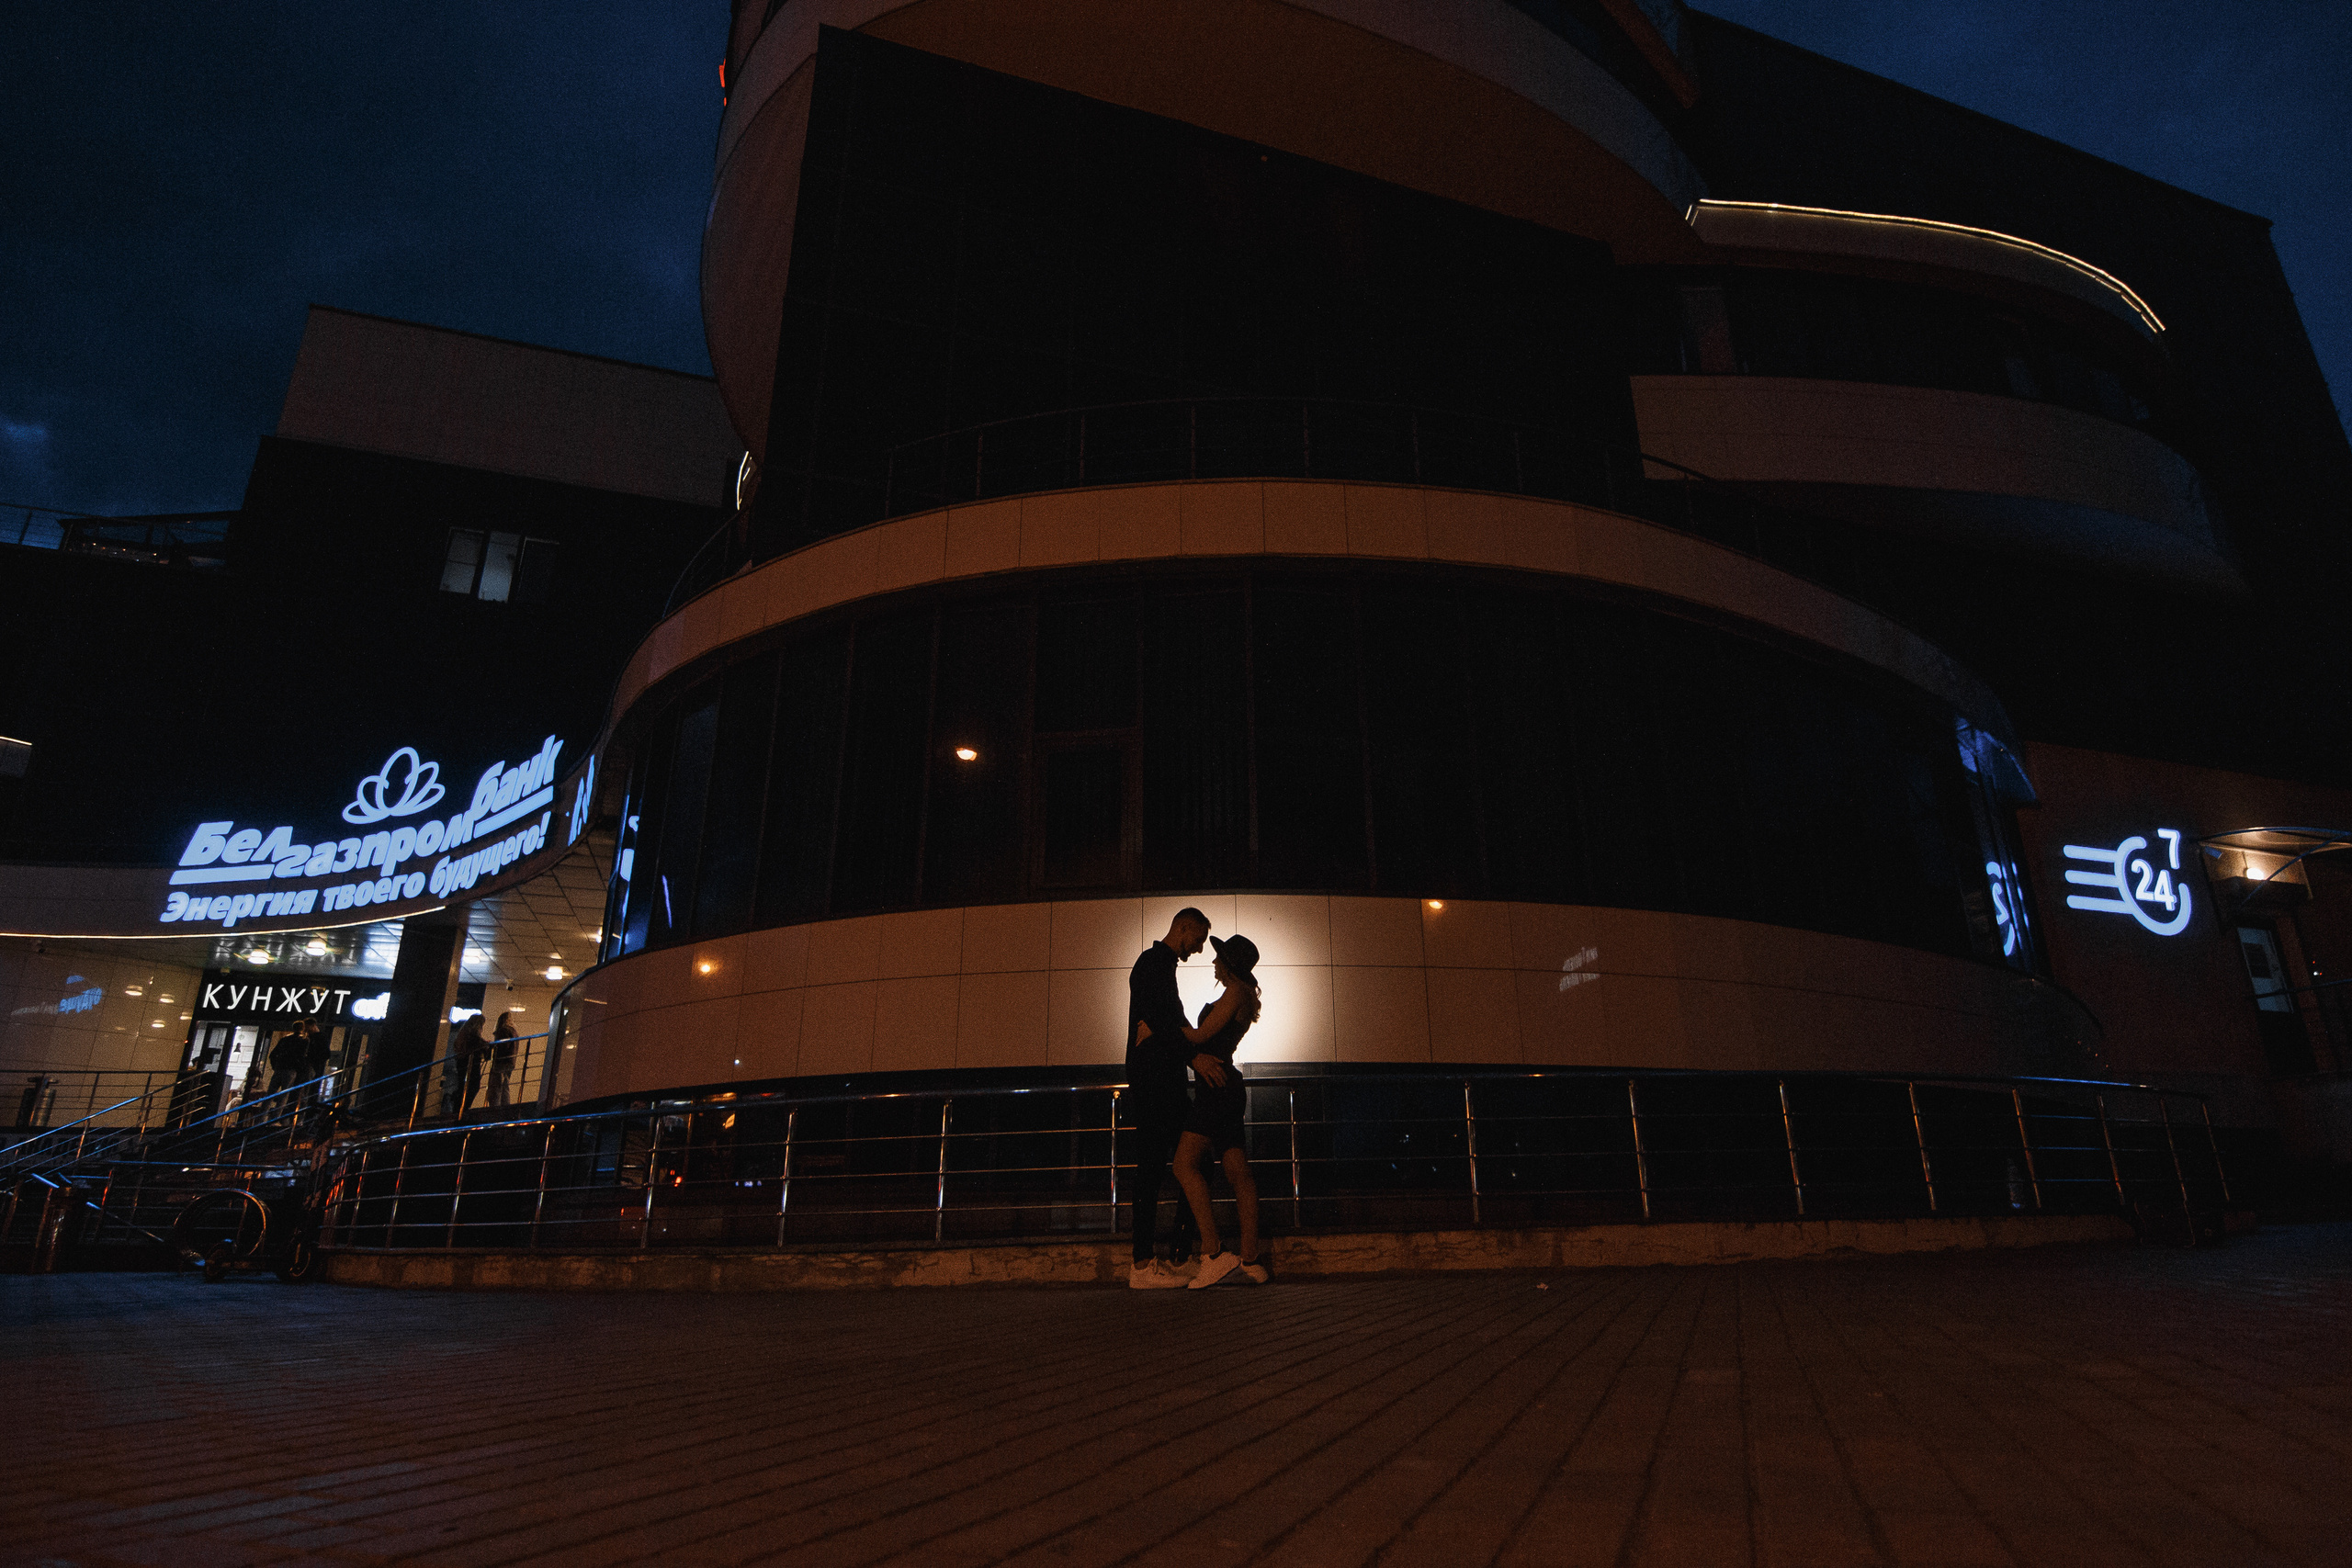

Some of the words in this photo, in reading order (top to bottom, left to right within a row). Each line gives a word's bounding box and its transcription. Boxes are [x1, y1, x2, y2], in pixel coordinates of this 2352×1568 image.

[160, 890, 318, 927] Энергия
[322, 870, 425, 912] твоего
[430, 810, 551, 899] будущего!
[2132, 859, 2177, 911] 24
[202, 983, 352, 1015] КУНЖУТ
